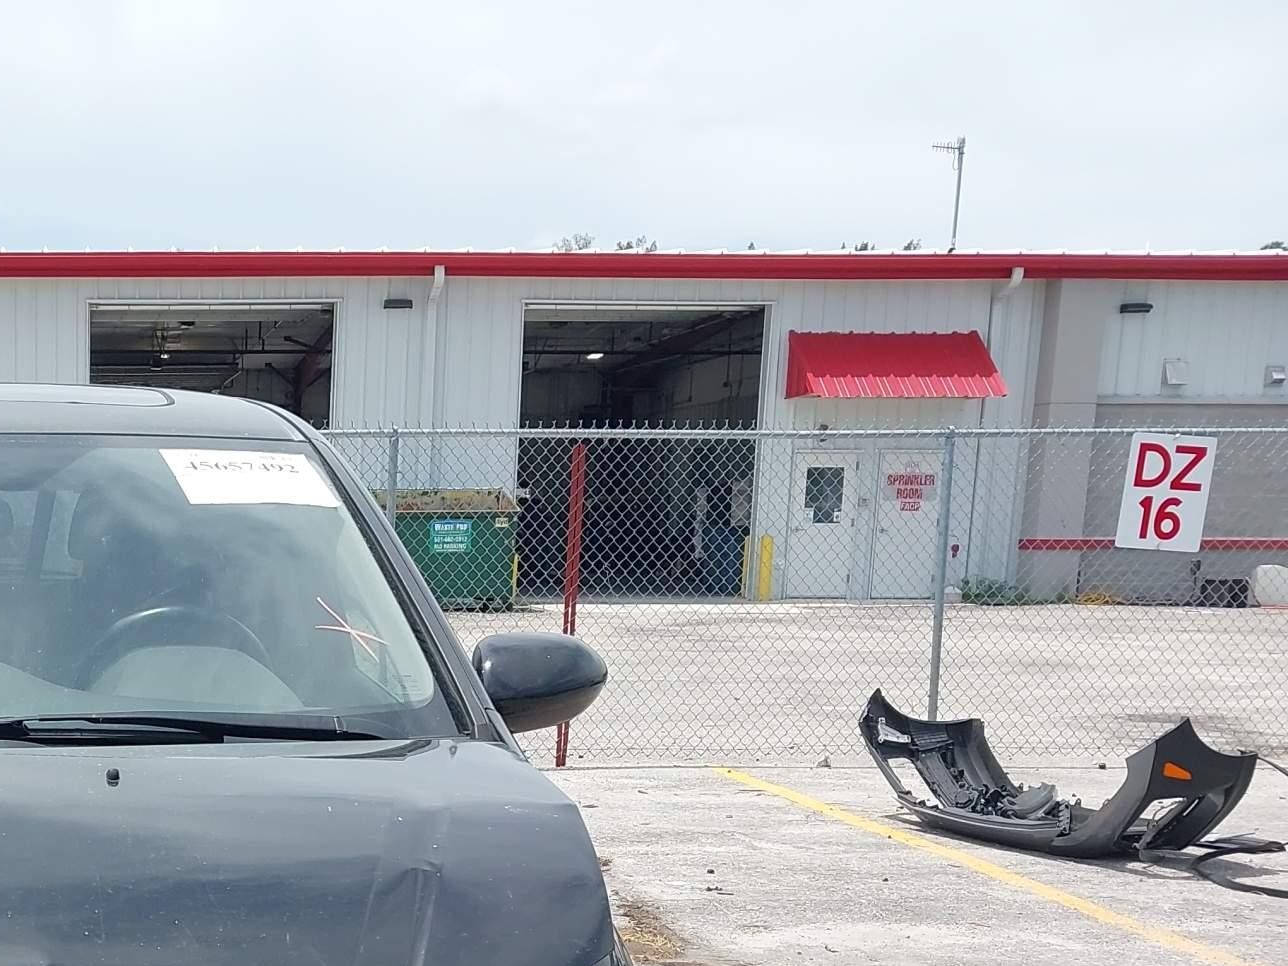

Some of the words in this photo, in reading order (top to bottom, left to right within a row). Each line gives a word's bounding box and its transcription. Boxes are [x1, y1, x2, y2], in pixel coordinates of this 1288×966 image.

[886, 474, 936, 486] SPRINKLER
[1133, 442, 1209, 492] DZ
[896, 487, 923, 500] ROOM
[1138, 496, 1183, 541] 16
